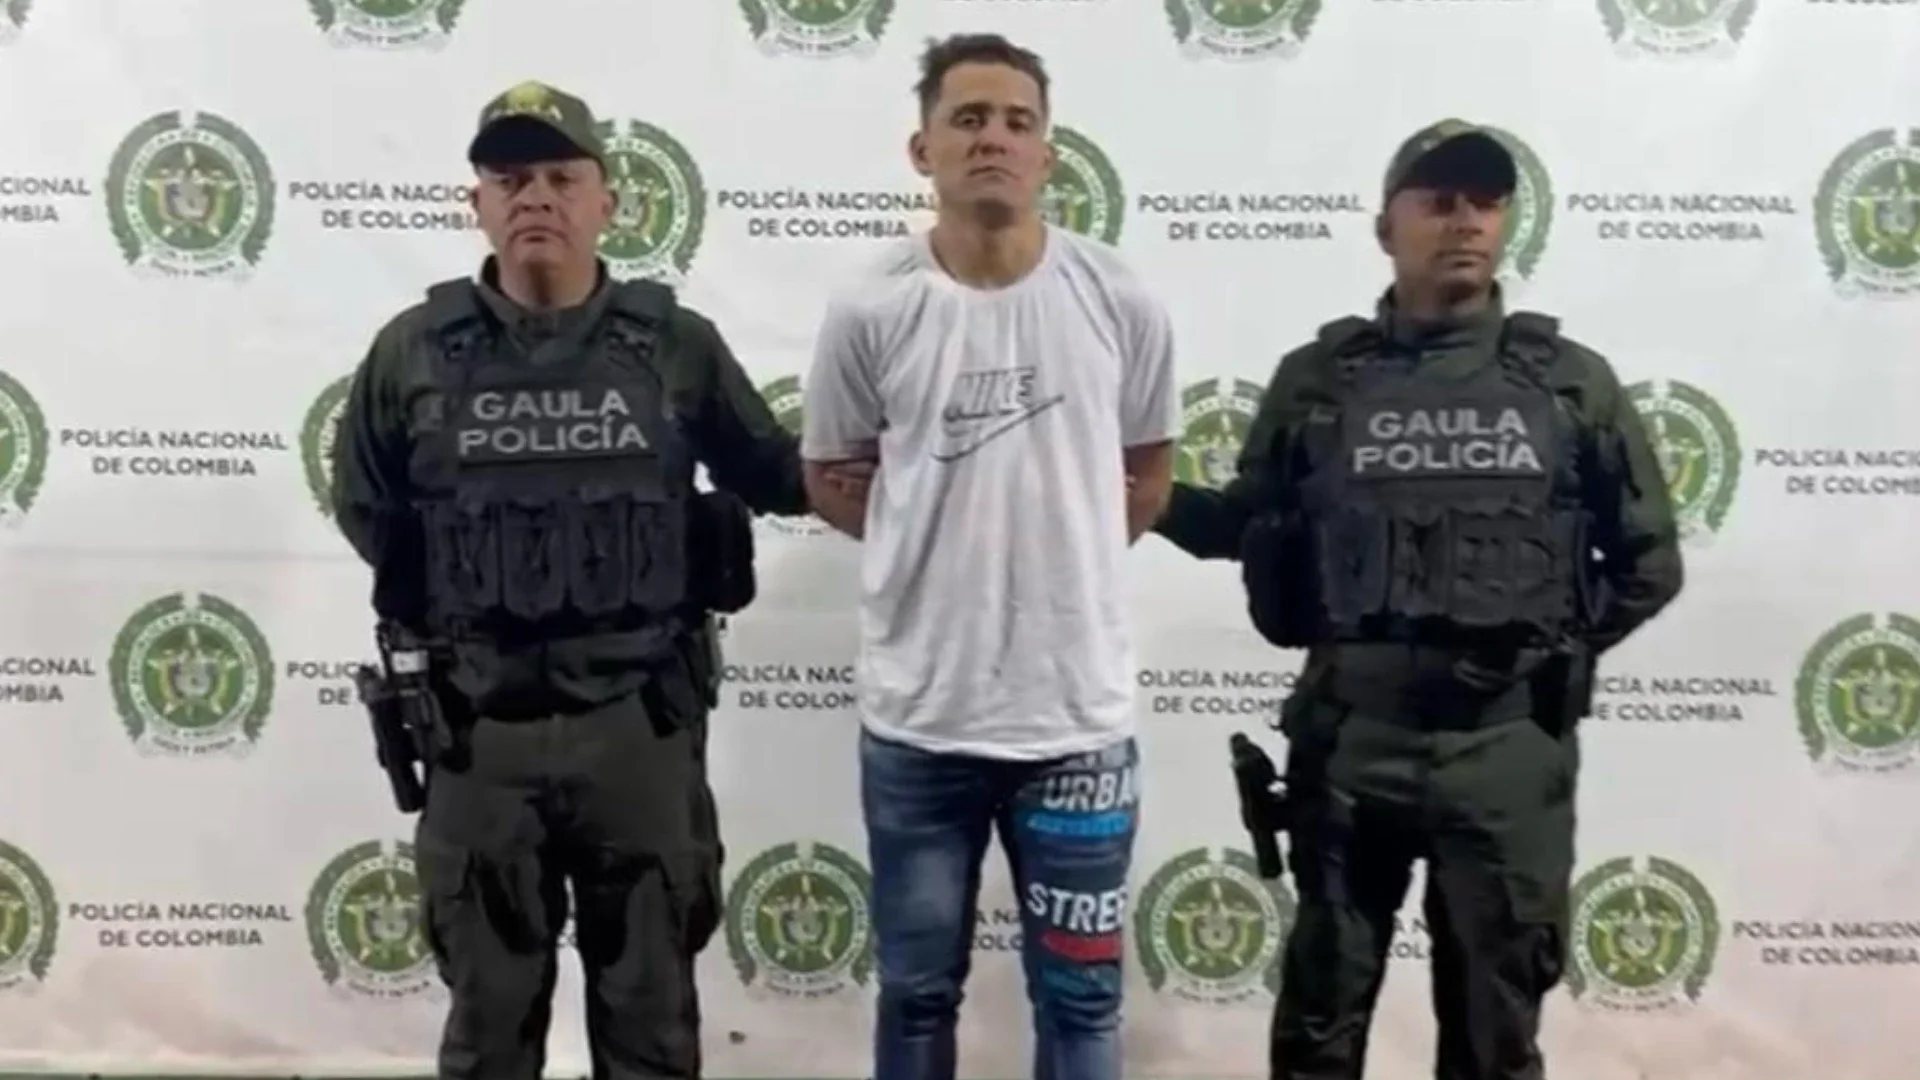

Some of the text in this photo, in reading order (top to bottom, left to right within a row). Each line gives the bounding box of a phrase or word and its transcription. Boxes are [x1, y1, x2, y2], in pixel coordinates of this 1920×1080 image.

[1238, 193, 1366, 214] NACIONAL
[1669, 193, 1798, 216] NACIONAL
[321, 208, 480, 230] DE COLOMBI
[748, 217, 911, 239] DE COLOMBIA
[1168, 221, 1333, 241] DE COLOMBIA
[1597, 220, 1765, 242] DE COLOMBIA
[942, 365, 1037, 422] NIKE
[473, 388, 630, 421] GAULA
[1368, 408, 1528, 440] GAULA
[158, 430, 289, 451] NACIONAL
[458, 415, 648, 457] POLICÍA
[1353, 434, 1544, 474] POLICÍA
[91, 455, 257, 477] DE COLOMBIA
[1785, 475, 1816, 495] DE
[0, 657, 97, 677] CIONAL
[317, 687, 351, 706] DE
[1649, 677, 1778, 697] NACIONAL
[738, 689, 769, 709] DE
[1152, 695, 1183, 714] DE
[1616, 702, 1744, 722] COLOMBIA
[167, 902, 294, 923] NACIONAL
[98, 928, 264, 948] DE COLOMBIA
[1761, 946, 1792, 965] DE
